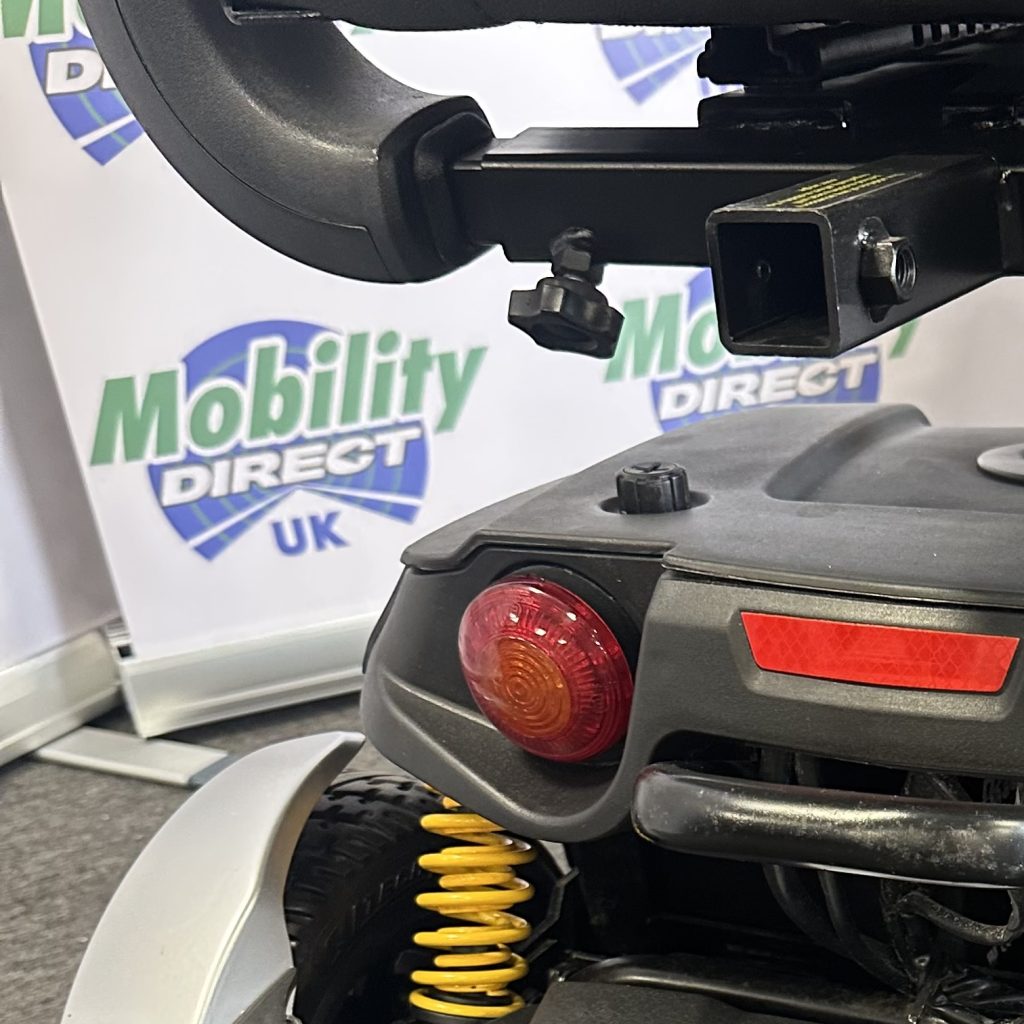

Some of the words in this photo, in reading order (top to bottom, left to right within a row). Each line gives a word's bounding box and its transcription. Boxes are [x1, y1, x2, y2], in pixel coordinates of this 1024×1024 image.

[89, 330, 488, 467] Mobility
[660, 352, 879, 421] DIRECT
[160, 425, 424, 507] DIRECT
[272, 512, 349, 556] UK
